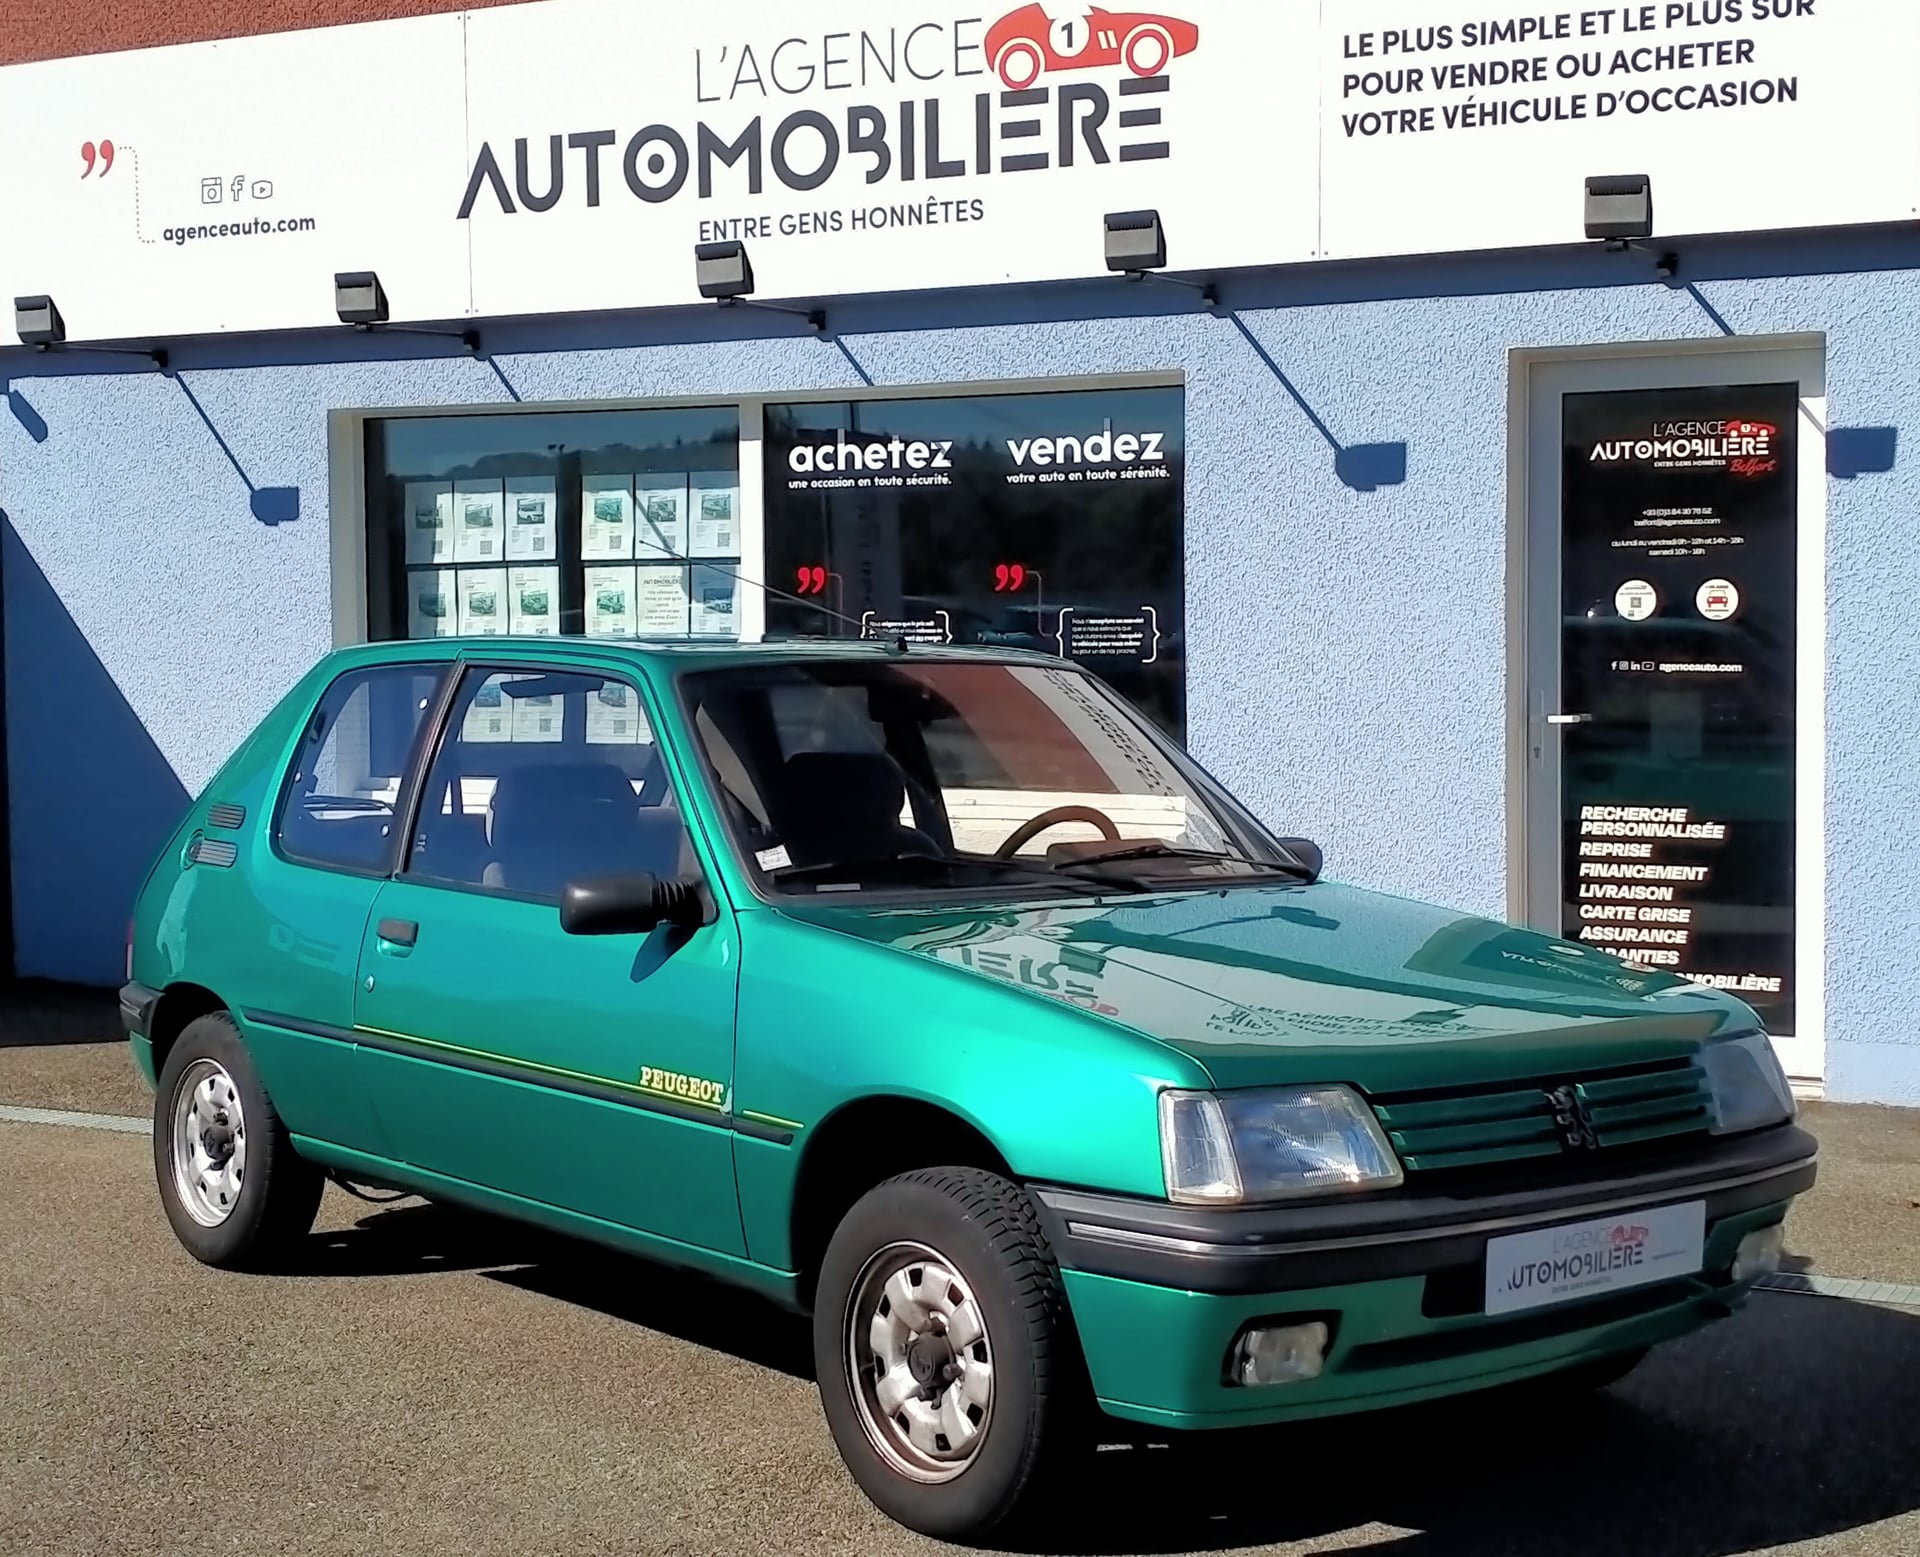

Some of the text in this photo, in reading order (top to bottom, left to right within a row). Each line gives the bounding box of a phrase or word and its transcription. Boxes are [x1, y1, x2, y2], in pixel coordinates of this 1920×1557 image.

[1059, 23, 1076, 49] 1
[1343, 33, 1374, 58] LE
[1382, 25, 1454, 54] PLUS
[1461, 15, 1570, 48] SIMPLE
[1580, 10, 1616, 36] ET
[1622, 6, 1656, 32] LE
[1664, 0, 1742, 28] PLUS
[696, 18, 983, 103] L'AGENCE
[1342, 38, 1754, 97] POUR VENDRE OU ACHETER
[1342, 77, 1797, 137] VOTRE VÉHICULE D'OCCASION
[699, 196, 984, 242] ENTRE GENS HONNÊTES
[163, 217, 316, 245] agenceauto.com
[1653, 420, 1727, 437] L'AGENCE
[788, 428, 953, 472] achetez
[1006, 418, 1164, 466] vendez
[1006, 465, 1171, 483] votre auto en toute sérénité.
[1729, 457, 1776, 477] Belfort
[788, 472, 952, 489] une occasion en toute sécurité.
[1658, 662, 1743, 673] agenceauto.com
[1581, 806, 1688, 822] RECHERCHE
[1580, 822, 1725, 839] PERSONNALISÉE
[1580, 842, 1652, 858] REPRISE
[1580, 863, 1708, 881] FINANCEMENT
[1580, 884, 1673, 901] LIVRAISON
[1580, 904, 1691, 923] CARTE GRISE
[1579, 926, 1688, 944] ASSURANCE
[1674, 972, 1782, 992] MOBILIÈRE
[640, 1066, 724, 1102] PEUGEOT
